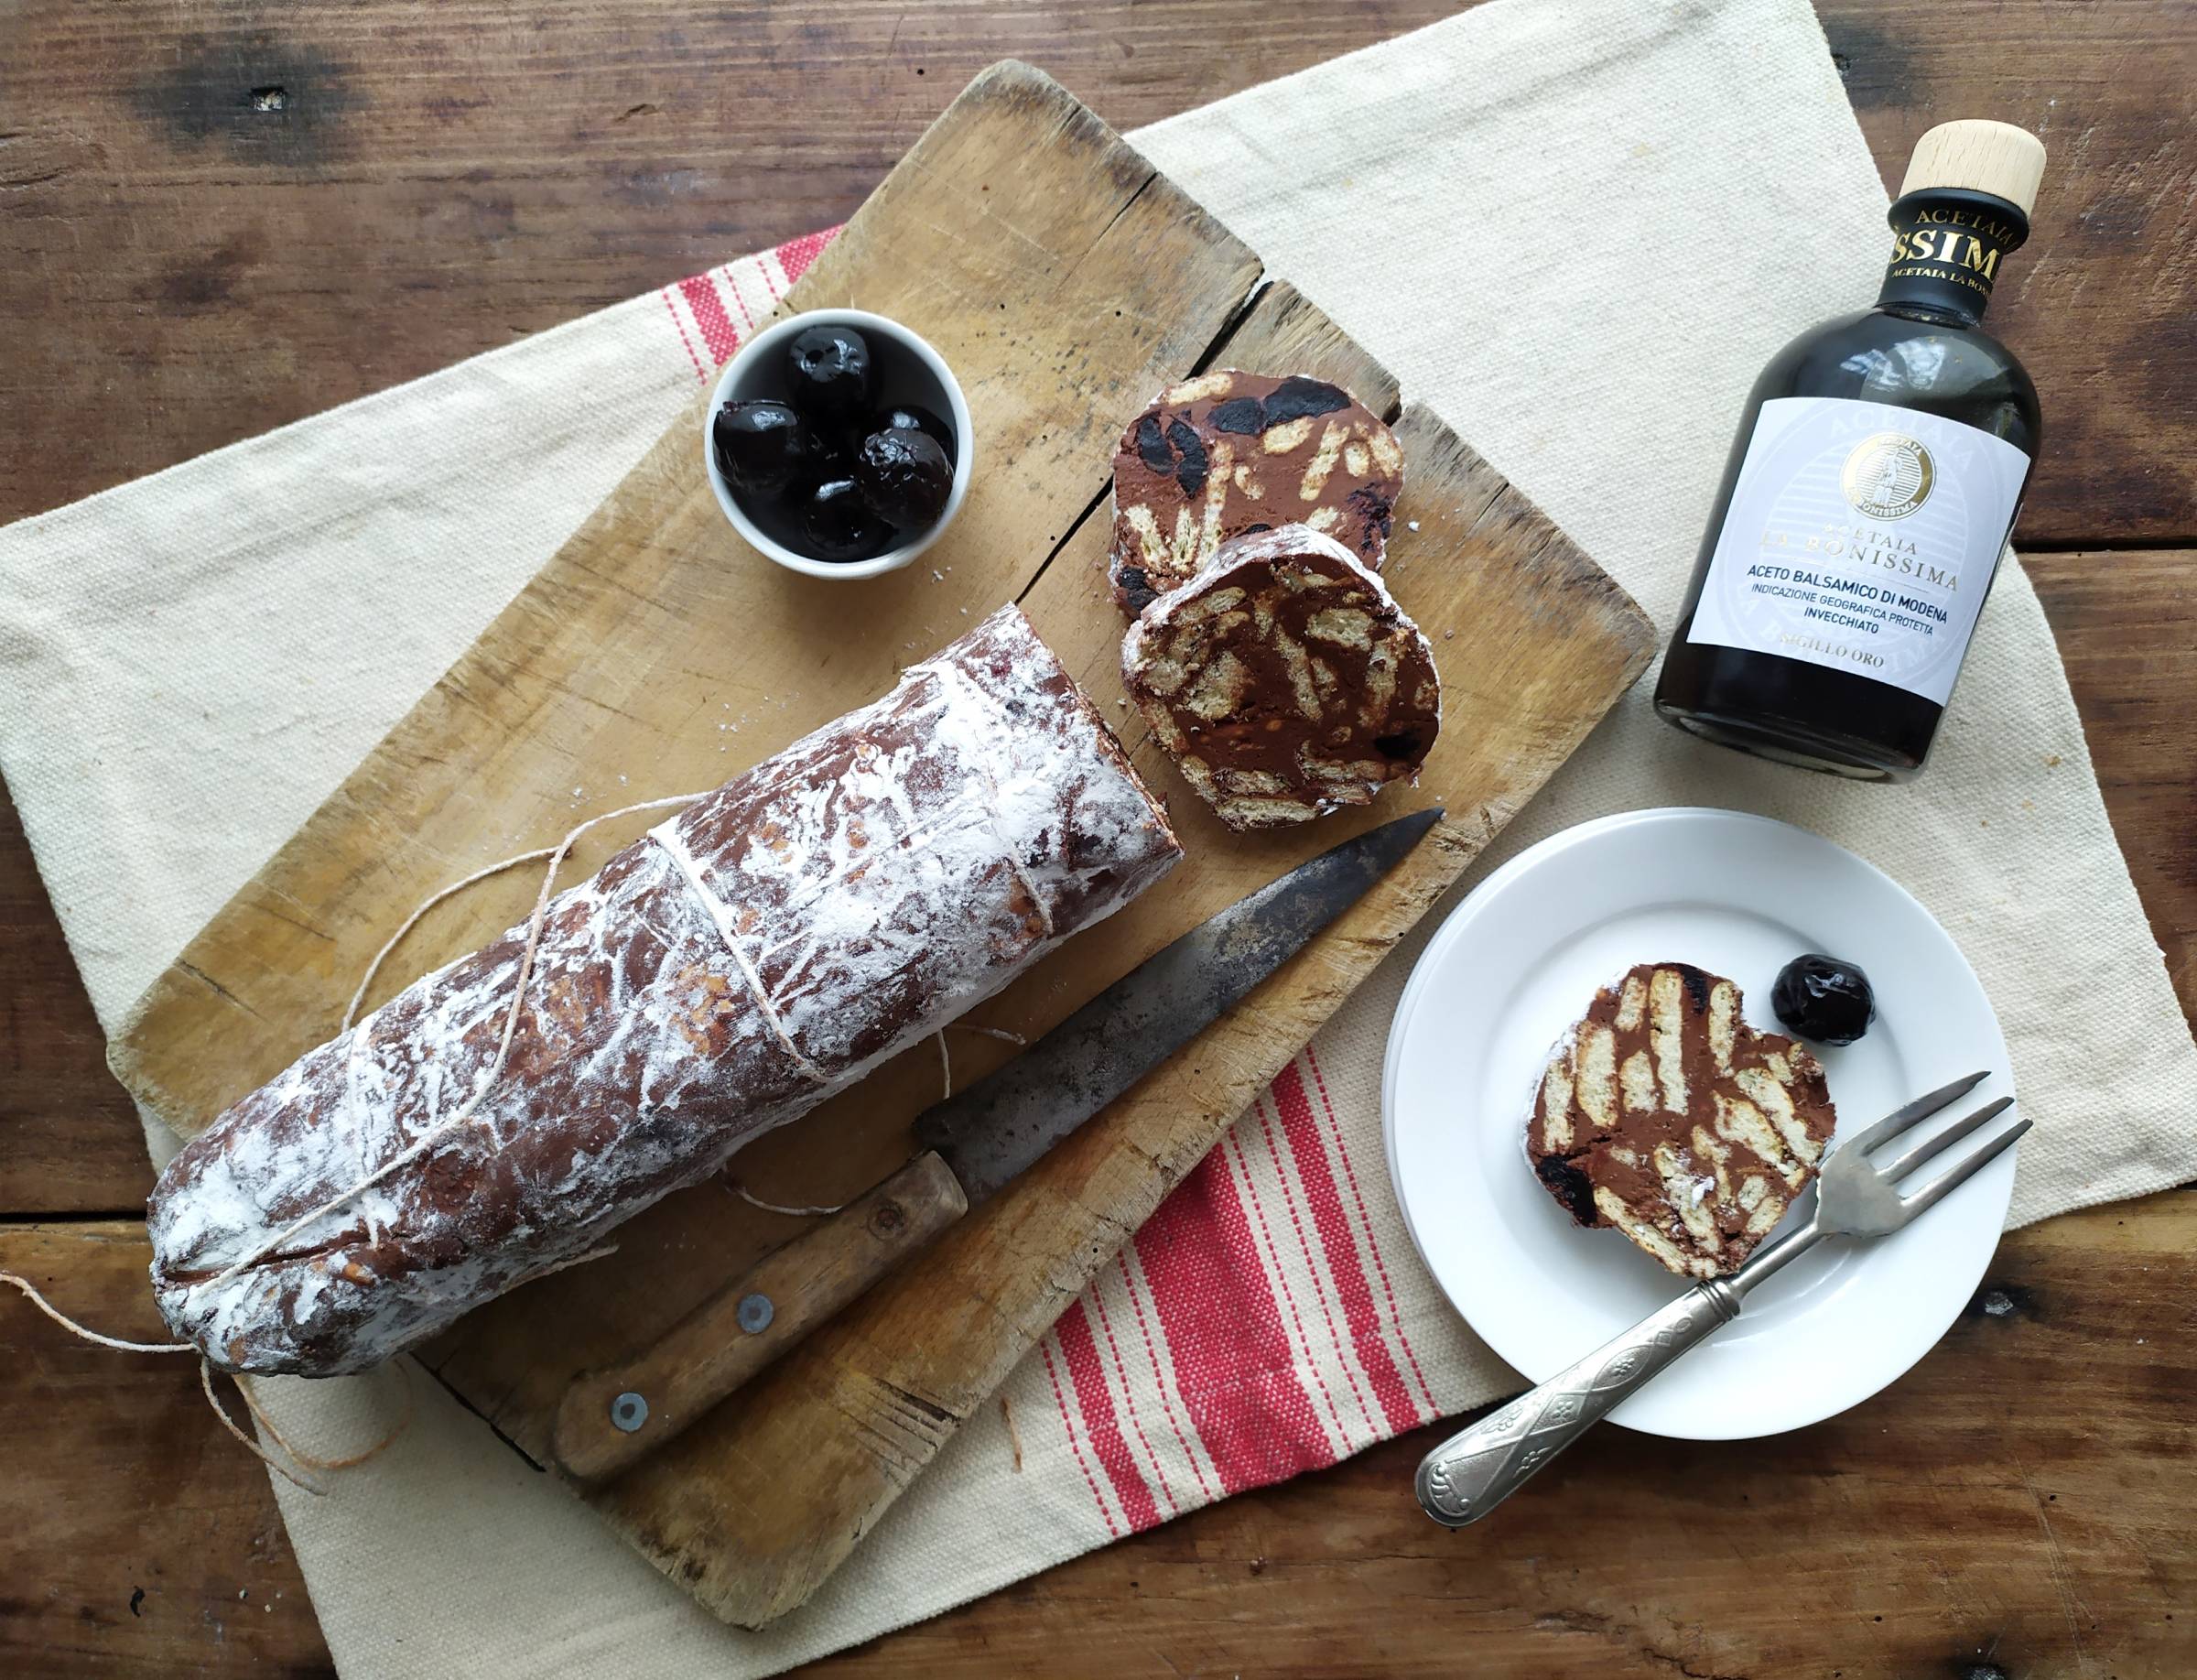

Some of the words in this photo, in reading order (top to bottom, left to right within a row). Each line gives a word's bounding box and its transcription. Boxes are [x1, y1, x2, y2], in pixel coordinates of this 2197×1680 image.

[1891, 266, 1946, 279] ACETAIA
[1949, 272, 1965, 285] LA
[1824, 522, 1918, 555] ACETAIA
[1758, 530, 1788, 547] LA
[1805, 536, 1958, 591] BONISSIMA
[1747, 564, 1791, 580] ACETO
[1792, 570, 1878, 600] BALSAMICO
[1879, 590, 1895, 605] DI
[1898, 597, 1948, 624] MODENA
[1751, 583, 1818, 603] INDICAZIONE
[1819, 594, 1887, 621] GEOGRAFICA
[1889, 612, 1933, 636] PROTETTA
[1803, 606, 1879, 634] INVECCHIATO
[1780, 634, 1847, 657] SIGILLO
[1851, 649, 1884, 668] ORO
